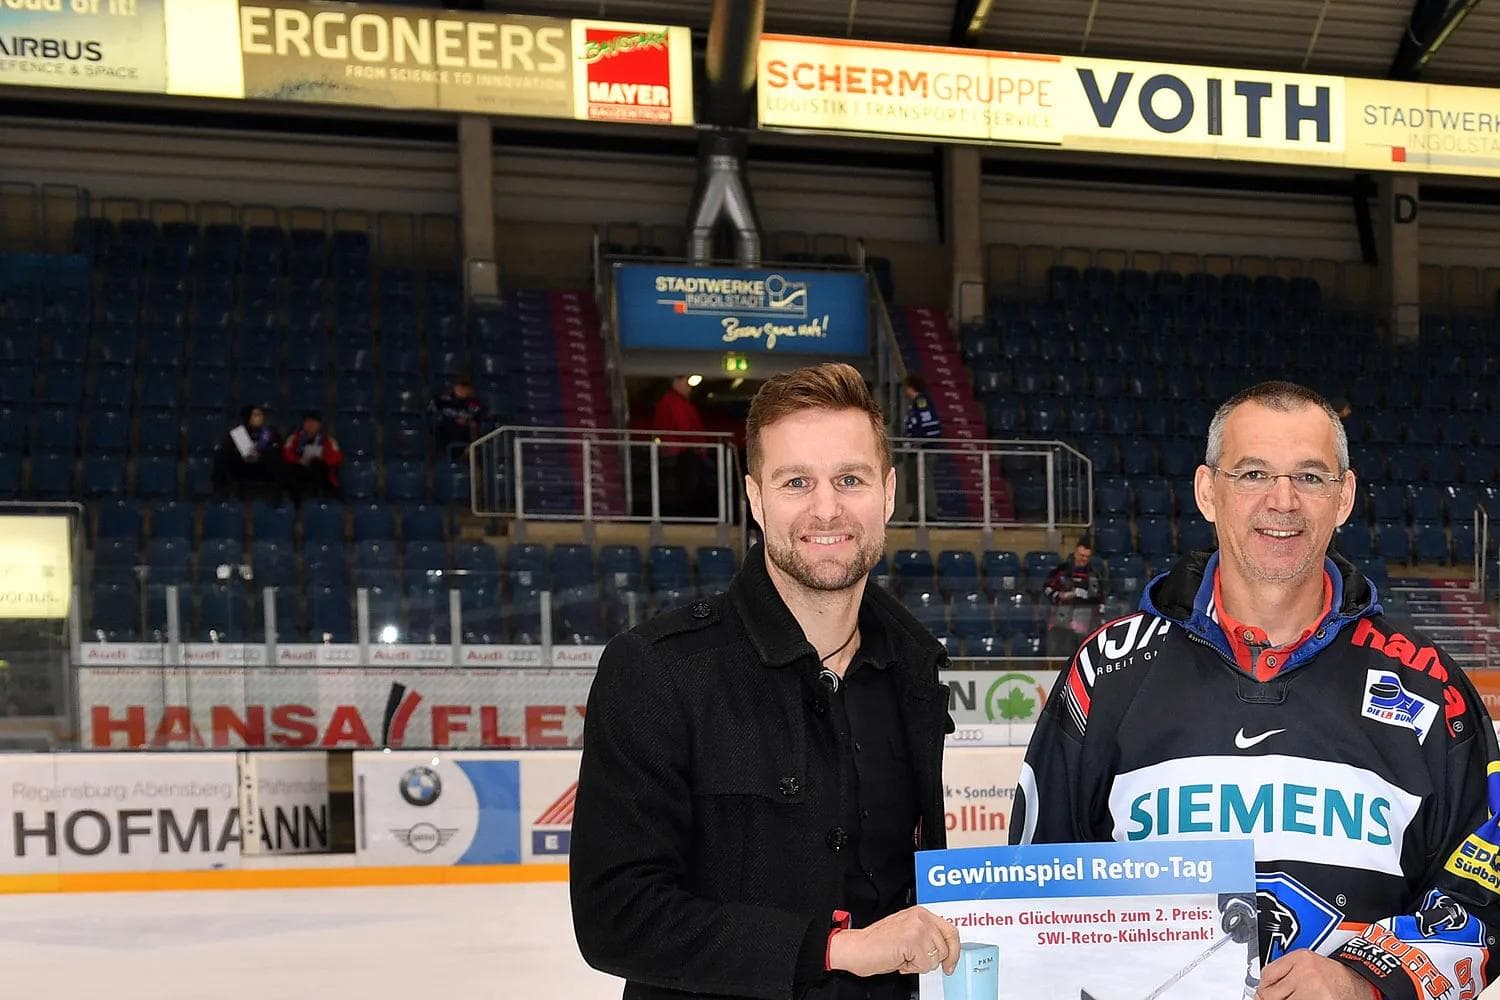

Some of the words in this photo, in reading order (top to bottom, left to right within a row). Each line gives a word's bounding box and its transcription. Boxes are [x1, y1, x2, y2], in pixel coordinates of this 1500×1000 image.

[242, 11, 567, 74] ERGONEERS
[85, 65, 139, 79] SPACE
[345, 65, 387, 81] FROM
[389, 68, 449, 84] SCIENCE
[454, 72, 472, 86] TO
[475, 75, 567, 92] INNOVATION
[767, 60, 1053, 108] SCHERMGRUPPE
[588, 81, 670, 107] MAYER
[1077, 67, 1330, 143] VOITH
[766, 97, 849, 117] LOGISTIK
[983, 109, 1054, 130] SERVICE
[1394, 194, 1416, 224] D
[655, 275, 767, 296] STADTWERKE
[685, 293, 765, 308] INGOLSTADT
[91, 704, 374, 748] HANSA
[12, 781, 127, 801] Regensburg
[132, 780, 232, 800] Abensberg
[1127, 782, 1392, 845] SIEMENS
[927, 857, 1084, 888] Gewinnspiel
[1091, 856, 1214, 884] Retro-Tag
[940, 912, 1014, 927] erzlichen
[1018, 910, 1117, 926] Glückwunsch
[1118, 910, 1151, 923] zum
[1155, 908, 1169, 921] 2.
[1172, 907, 1214, 922] Preis:
[1037, 926, 1215, 946] SWI-Retro-Kühlschrank!
[1343, 945, 1393, 975] INGOLSTADT
[1347, 936, 1402, 968] ERC
